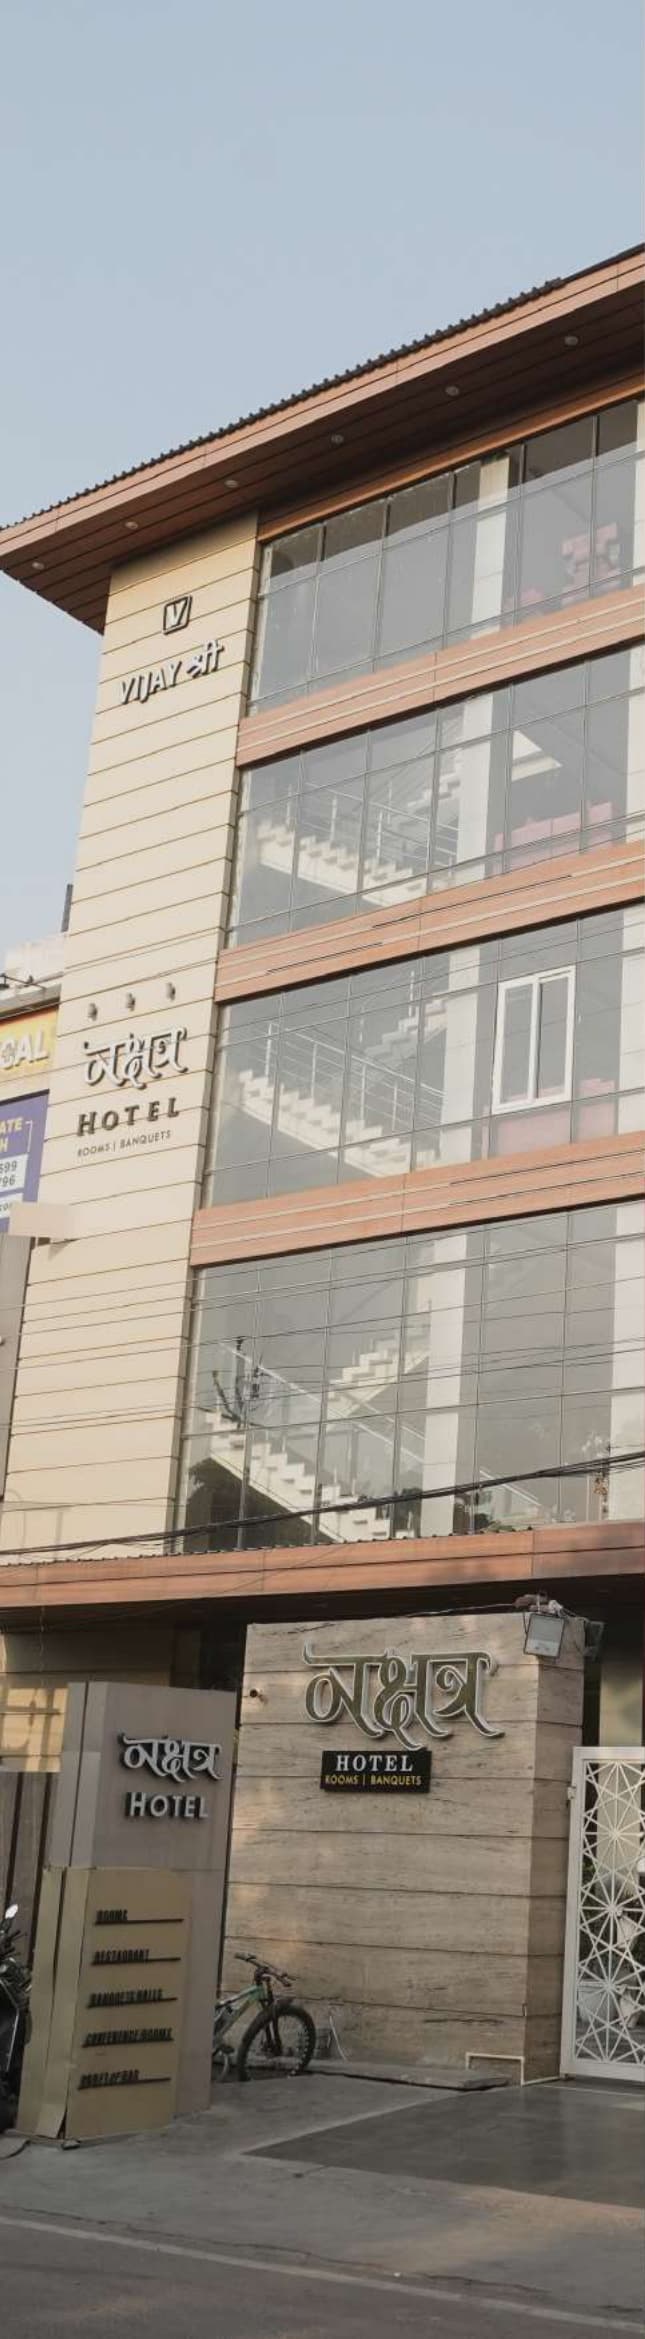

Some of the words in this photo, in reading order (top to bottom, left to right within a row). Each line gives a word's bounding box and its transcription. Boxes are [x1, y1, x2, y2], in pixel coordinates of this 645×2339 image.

[120, 661, 183, 705] VIJAY
[76, 1097, 180, 1137] HOTEL
[77, 1144, 111, 1158] ROOMS
[119, 1129, 172, 1150] BANQUETS
[303, 1640, 505, 1751] नक्षत्र
[119, 1731, 225, 1783] नक्षत्र
[335, 1754, 414, 1772] HOTEL
[325, 1774, 359, 1785] ROOMS
[370, 1774, 423, 1786] BANQUETS
[126, 1791, 209, 1818] HOTEL
[94, 1949, 150, 1964] RESTAURANT
